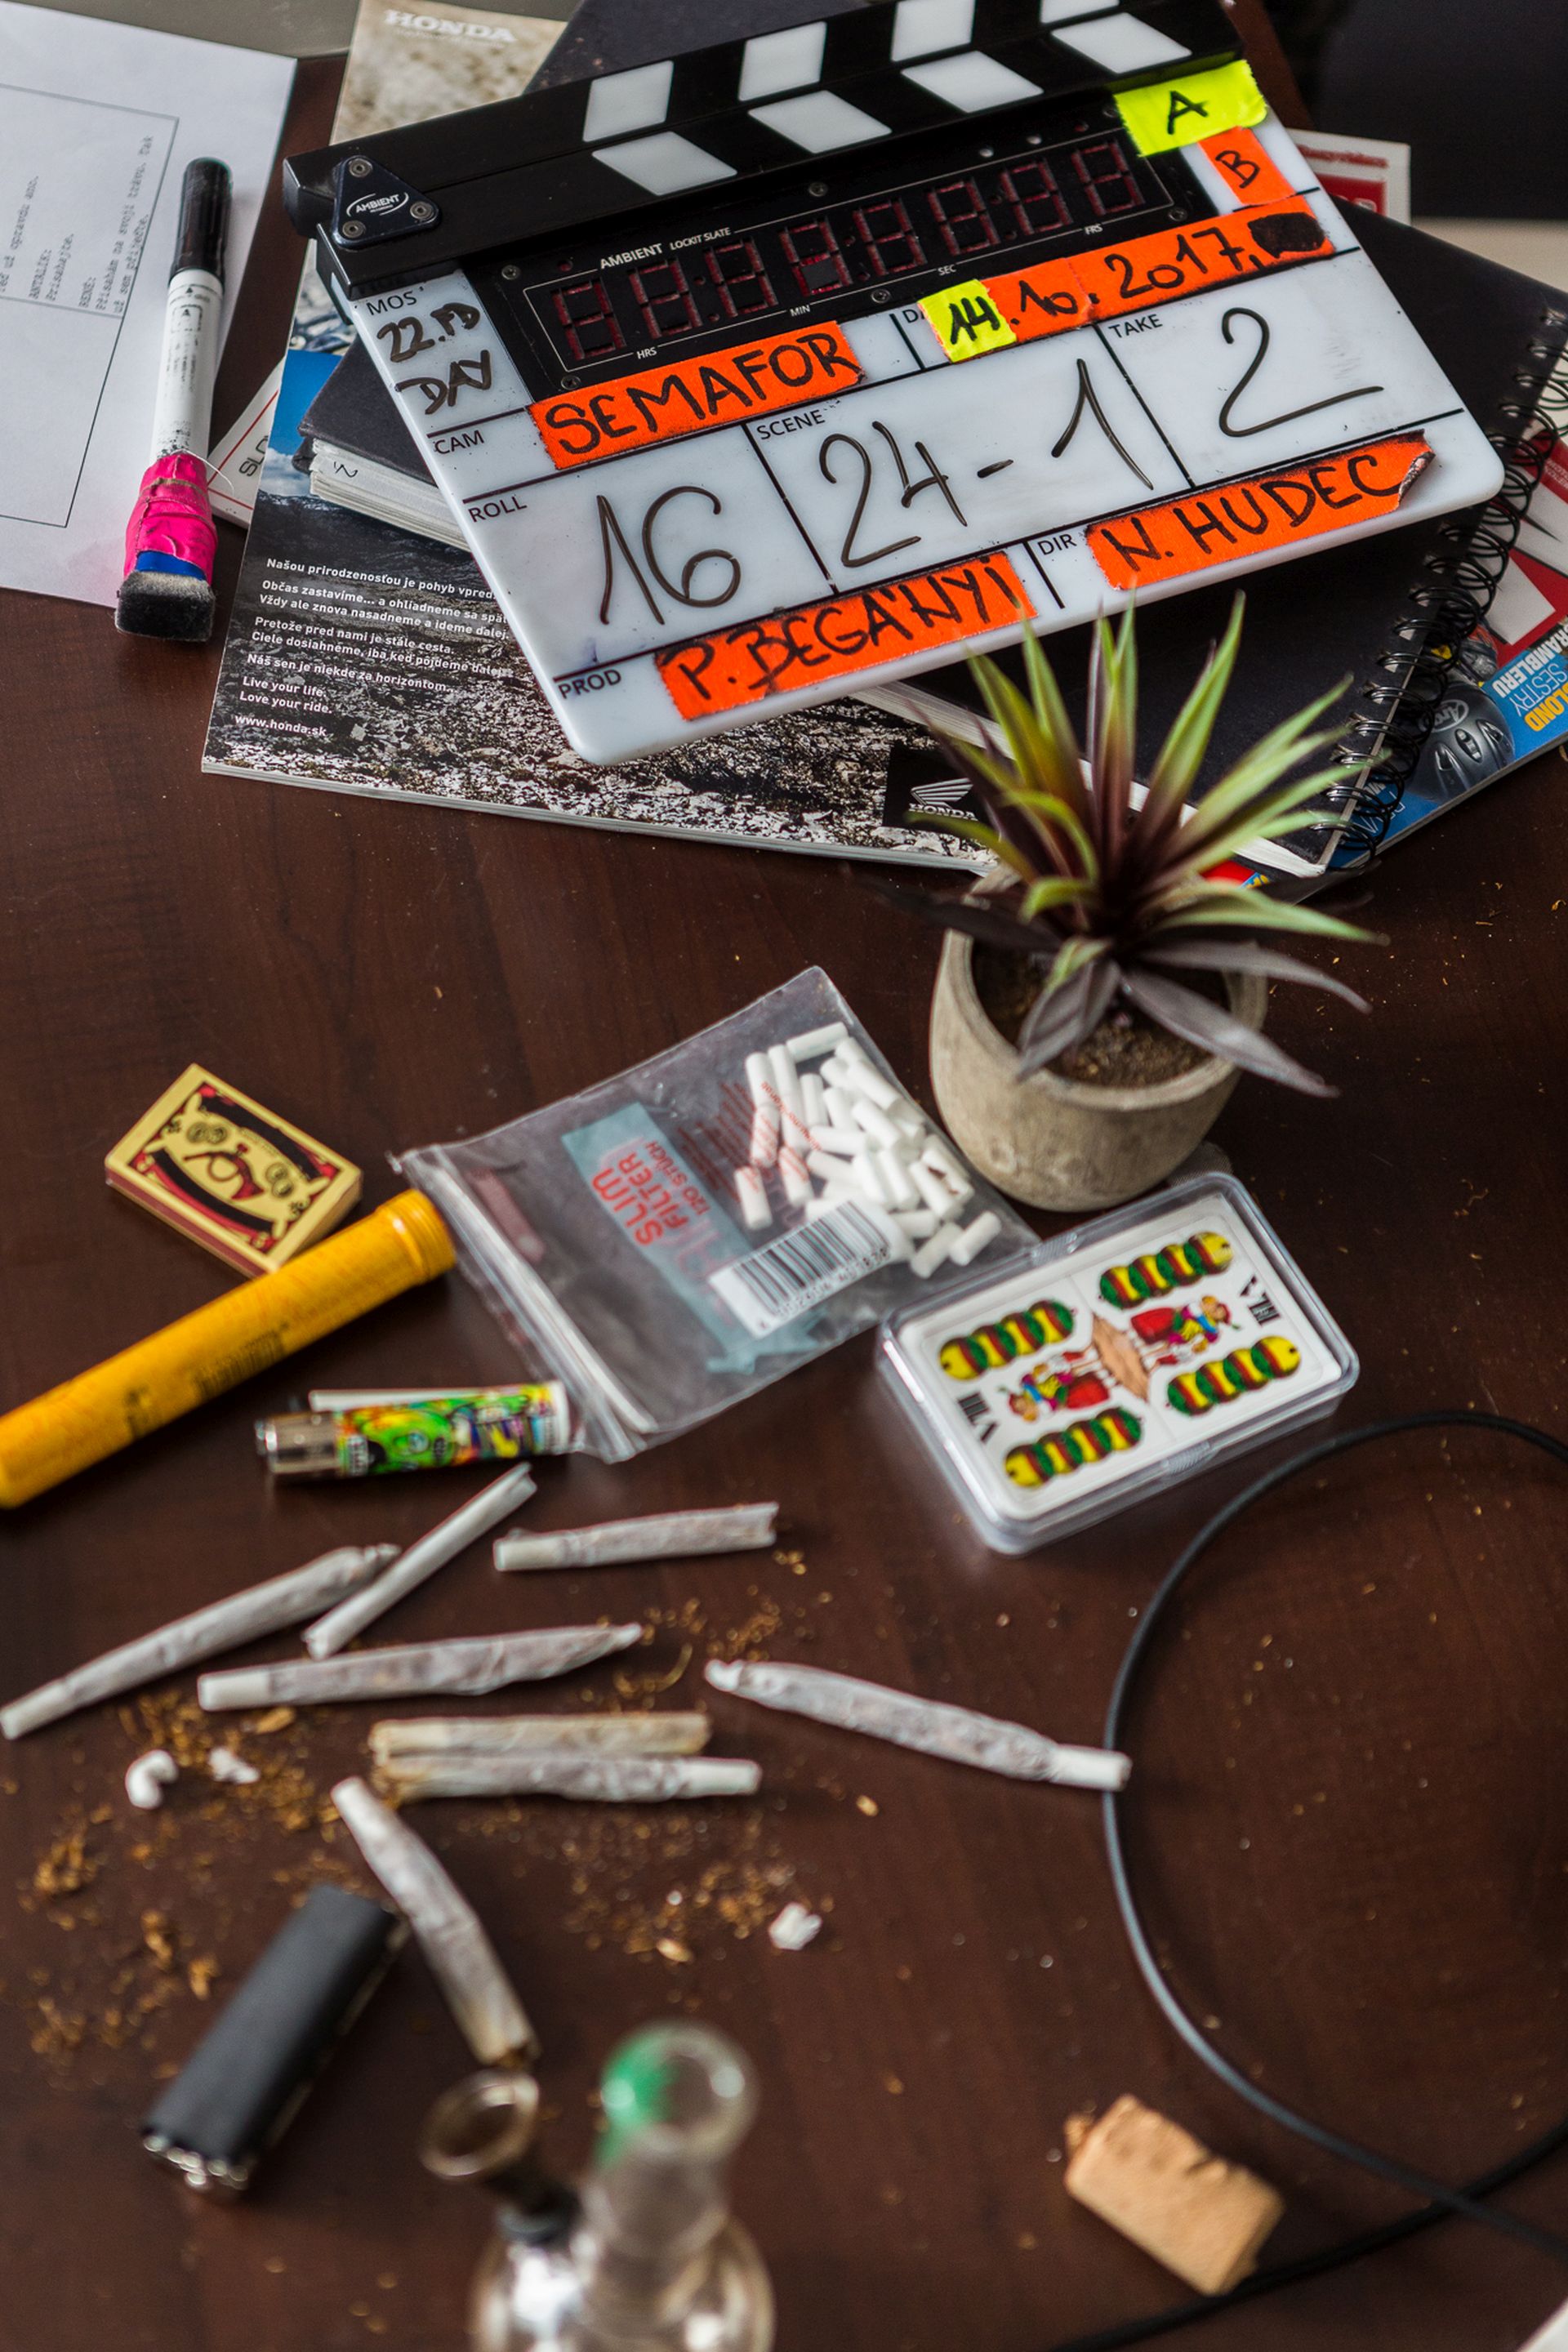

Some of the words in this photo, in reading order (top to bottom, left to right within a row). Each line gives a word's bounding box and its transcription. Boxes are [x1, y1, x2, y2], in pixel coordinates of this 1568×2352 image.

[385, 10, 518, 41] HONDA
[1167, 91, 1209, 135] A
[1215, 149, 1260, 188] B
[356, 194, 399, 213] AMBIENT
[1085, 223, 1103, 235] FRS
[600, 243, 663, 270] AMBIENT
[670, 235, 702, 251] LOCKIT
[703, 227, 732, 243] SLATE
[938, 264, 957, 276] SEC
[367, 291, 416, 316] MOS
[791, 305, 811, 317] MIN
[902, 309, 924, 323] D
[1109, 314, 1163, 338] TAKE
[637, 347, 657, 359] HRS
[395, 350, 492, 415] DAY
[1219, 306, 1385, 439] 2
[545, 333, 859, 453] SEMAFOR
[756, 410, 826, 441] SCENE
[434, 430, 484, 456] CAM
[468, 497, 528, 523] ROLL
[595, 484, 742, 626] 16
[1038, 533, 1076, 557] DIR
[267, 558, 305, 572] Našou
[308, 565, 401, 586] prirodzenosťou
[403, 577, 416, 589] je
[418, 581, 455, 595] pohyb
[262, 580, 298, 594] Občas
[301, 586, 375, 605] zastavíme...
[378, 598, 385, 606] a
[389, 599, 461, 618] ohliadneme
[463, 611, 478, 620] sa
[260, 594, 287, 608] Vždy
[290, 599, 310, 610] ale
[313, 604, 348, 616] znova
[351, 609, 421, 626] nasadneme
[425, 619, 432, 628] a
[434, 619, 473, 635] ideme
[476, 626, 510, 639] ďalej.
[255, 617, 302, 632] Pretože
[305, 624, 334, 637] pred
[337, 630, 367, 641] nami
[369, 633, 382, 644] je
[385, 637, 416, 648] stále
[417, 642, 454, 654] cesta.
[247, 653, 272, 666] Náš
[274, 658, 296, 670] sen
[298, 662, 310, 672] je
[314, 664, 356, 679] niekde
[359, 672, 372, 681] za
[252, 631, 283, 644] Ciele
[287, 636, 364, 657] dosiahneme,
[368, 648, 386, 658] iba
[390, 651, 415, 662] keď
[415, 656, 469, 672] pôjdeme
[243, 676, 269, 689] Live
[271, 683, 301, 693] your
[303, 685, 327, 697] life.
[557, 668, 621, 700] PROD
[1509, 663, 1567, 717] SESTRY
[240, 691, 270, 704] Love
[272, 697, 301, 708] your
[304, 702, 333, 715] ride.
[234, 715, 327, 737] www.honda.sk
[908, 803, 979, 822] HONDA
[618, 1152, 690, 1228] FILTER
[591, 1167, 665, 1247] SLIM
